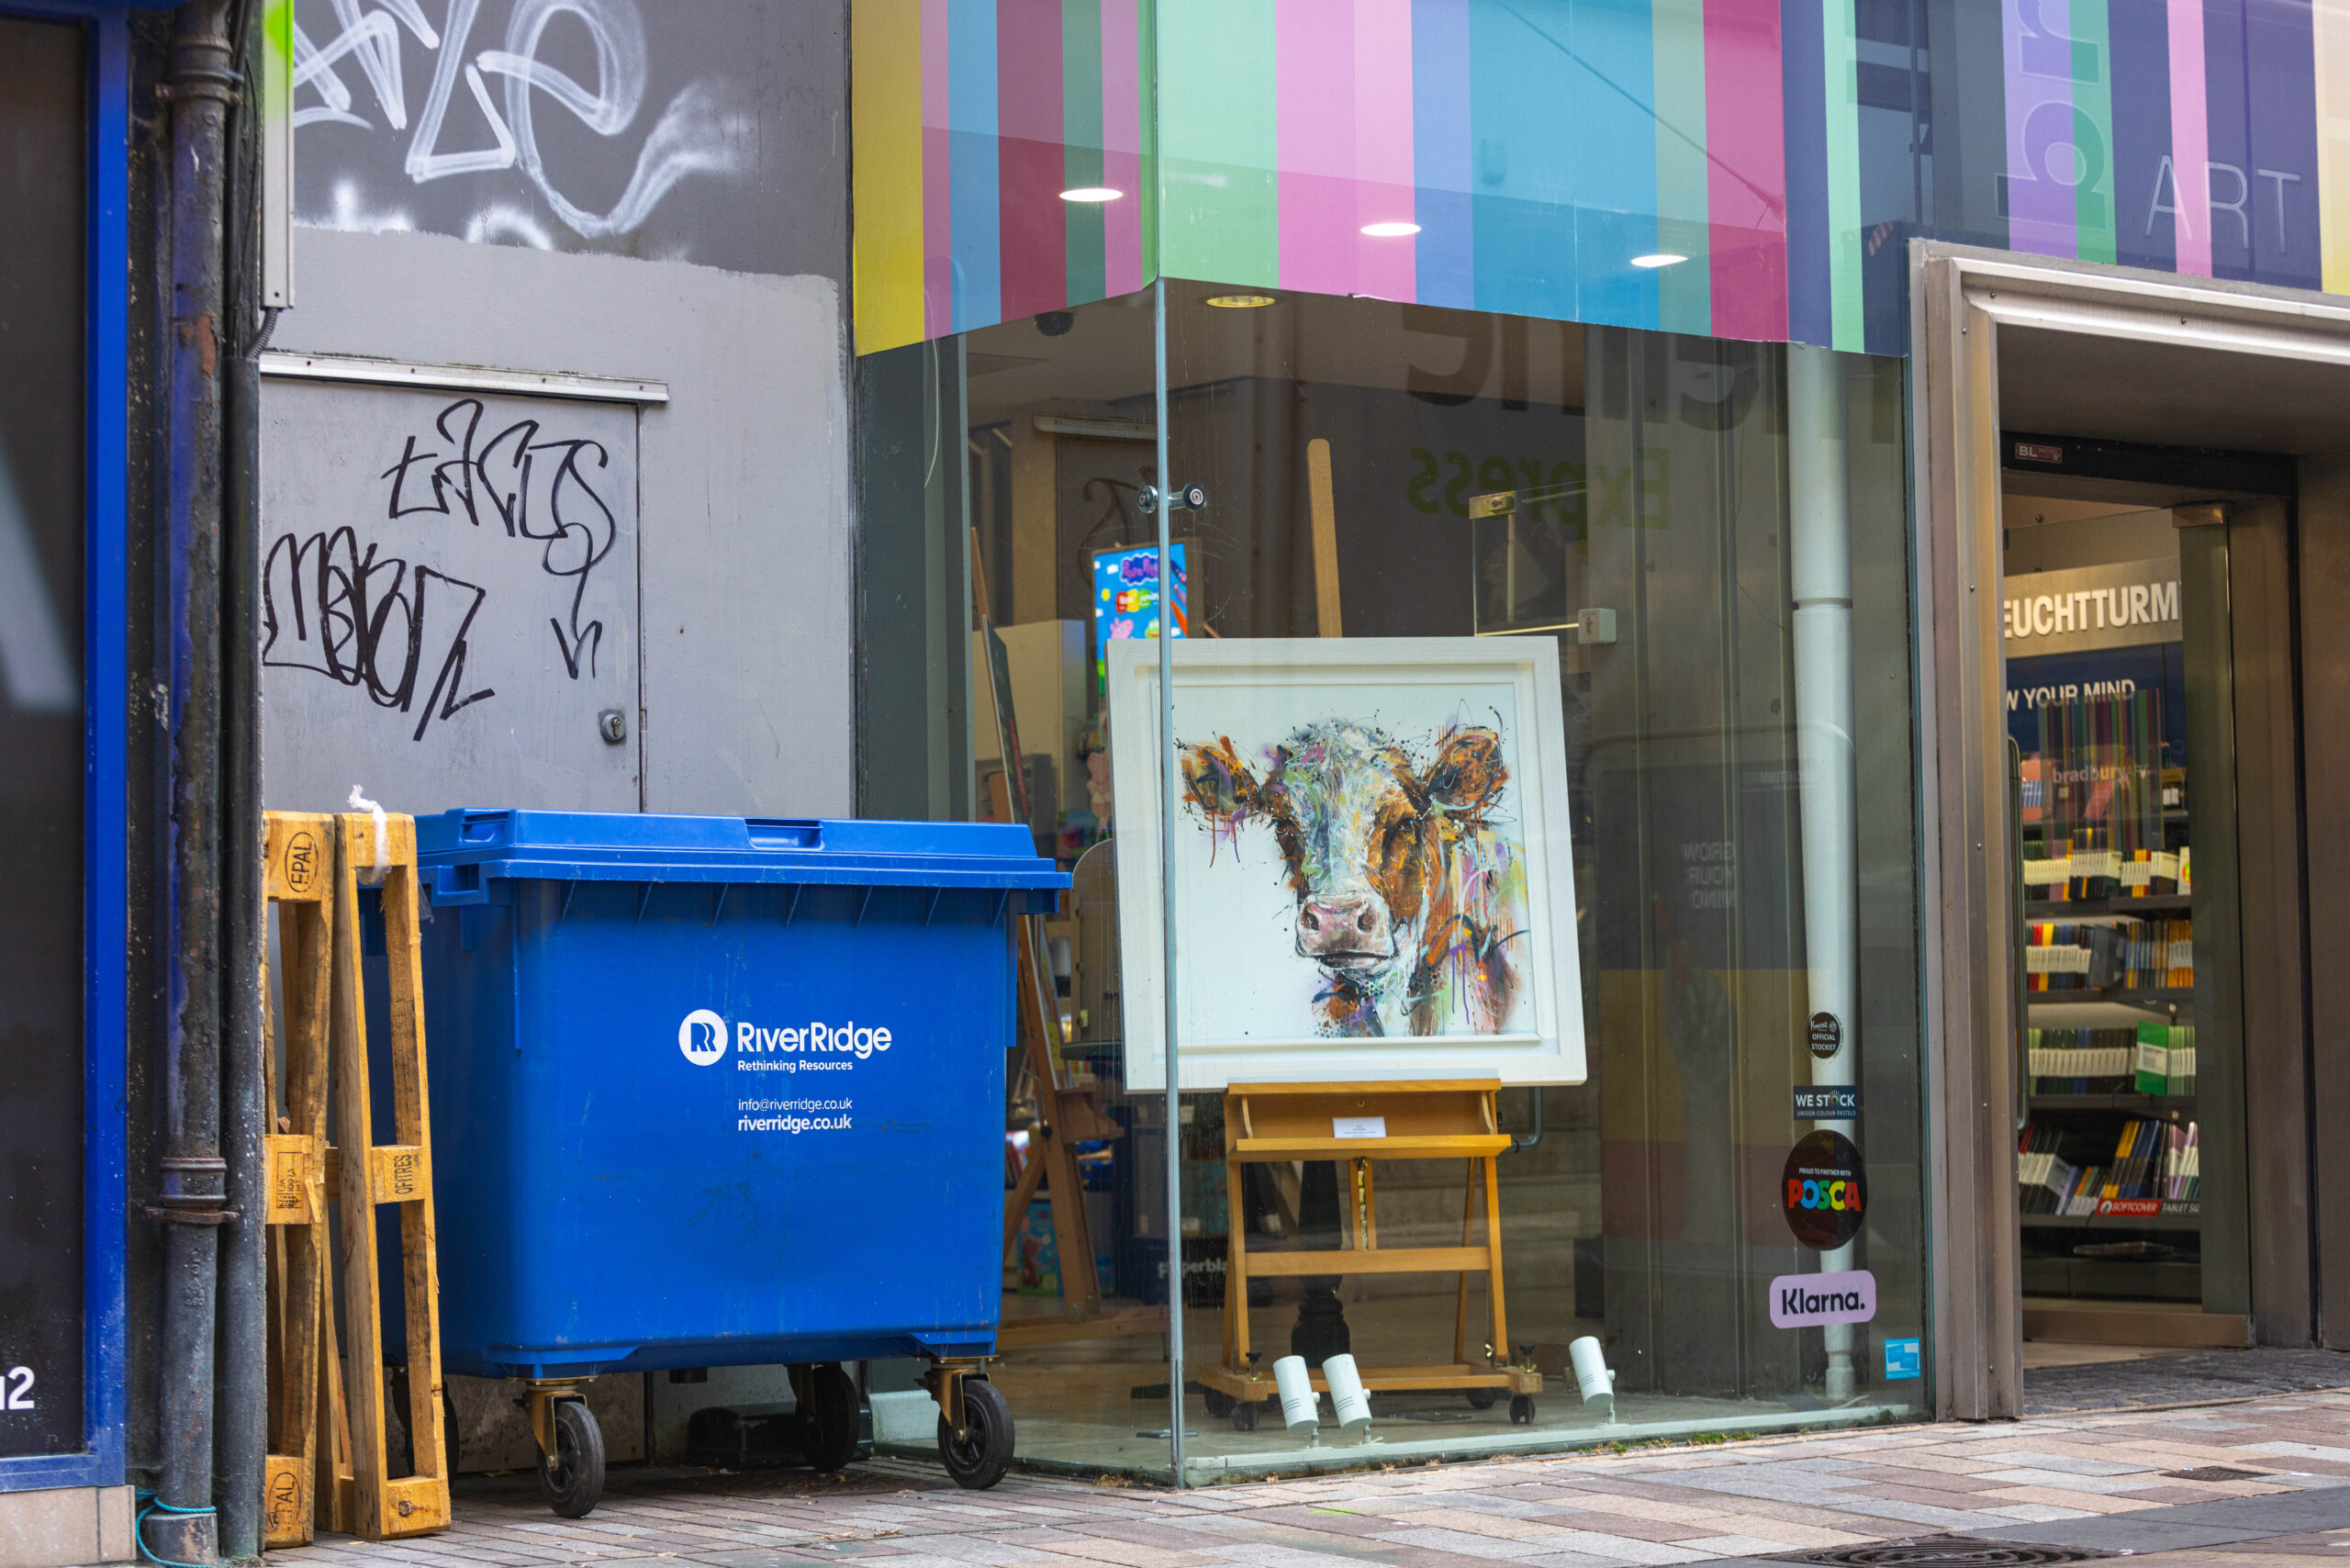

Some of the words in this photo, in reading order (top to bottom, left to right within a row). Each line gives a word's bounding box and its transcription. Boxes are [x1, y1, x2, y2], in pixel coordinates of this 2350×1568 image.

[2145, 154, 2301, 254] ART
[2023, 685, 2078, 710] YOUR
[2084, 679, 2135, 704] MIND
[737, 1021, 892, 1059] RiverRidge
[1811, 1043, 1836, 1051] STOCKIST
[1812, 1033, 1835, 1041] OFFICIAL
[737, 1060, 796, 1073] Rethinking
[799, 1059, 853, 1070] Resources
[738, 1097, 853, 1113] info@riverridge.co.uk
[1796, 1094, 1814, 1107] WE
[738, 1114, 852, 1135] riverridge.co.uk
[1799, 1167, 1814, 1175] PROUD
[1787, 1179, 1862, 1212] POSCA
[1782, 1288, 1865, 1316] Klarna.
[0, 1366, 35, 1410] 2
